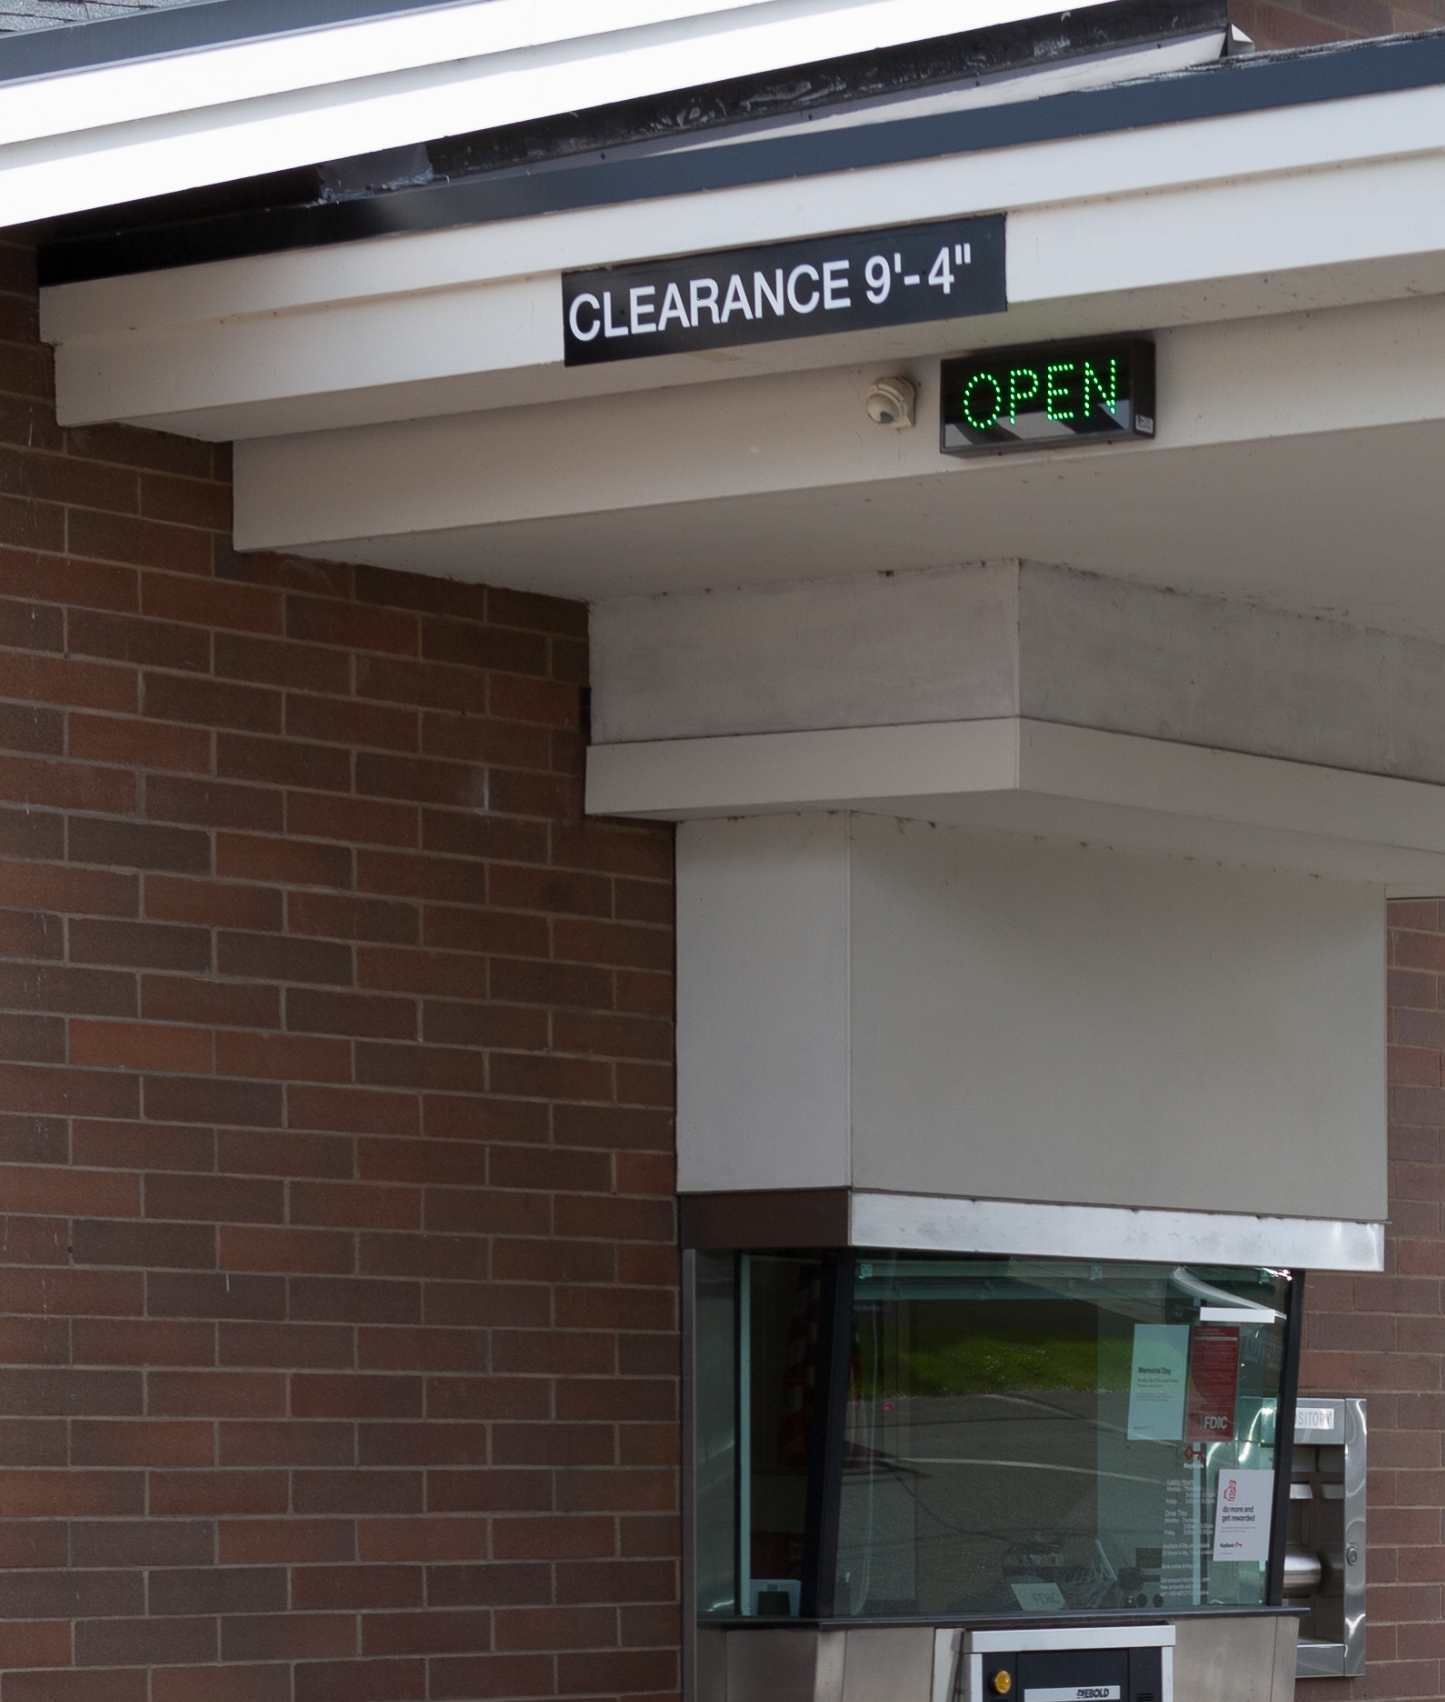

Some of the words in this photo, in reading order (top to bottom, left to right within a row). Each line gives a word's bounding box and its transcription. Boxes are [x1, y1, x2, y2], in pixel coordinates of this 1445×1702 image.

[568, 260, 852, 342] CLEARANCE
[865, 243, 972, 305] 9'-4"
[962, 359, 1118, 430] OPEN
[1203, 1416, 1228, 1430] FDIC
[1298, 1411, 1333, 1426] SITORY
[1222, 1505, 1229, 1513] do
[1244, 1505, 1254, 1513] and
[1221, 1515, 1230, 1524] get
[1231, 1513, 1256, 1522] rewarded
[1075, 1688, 1110, 1699] DIEBOLD
